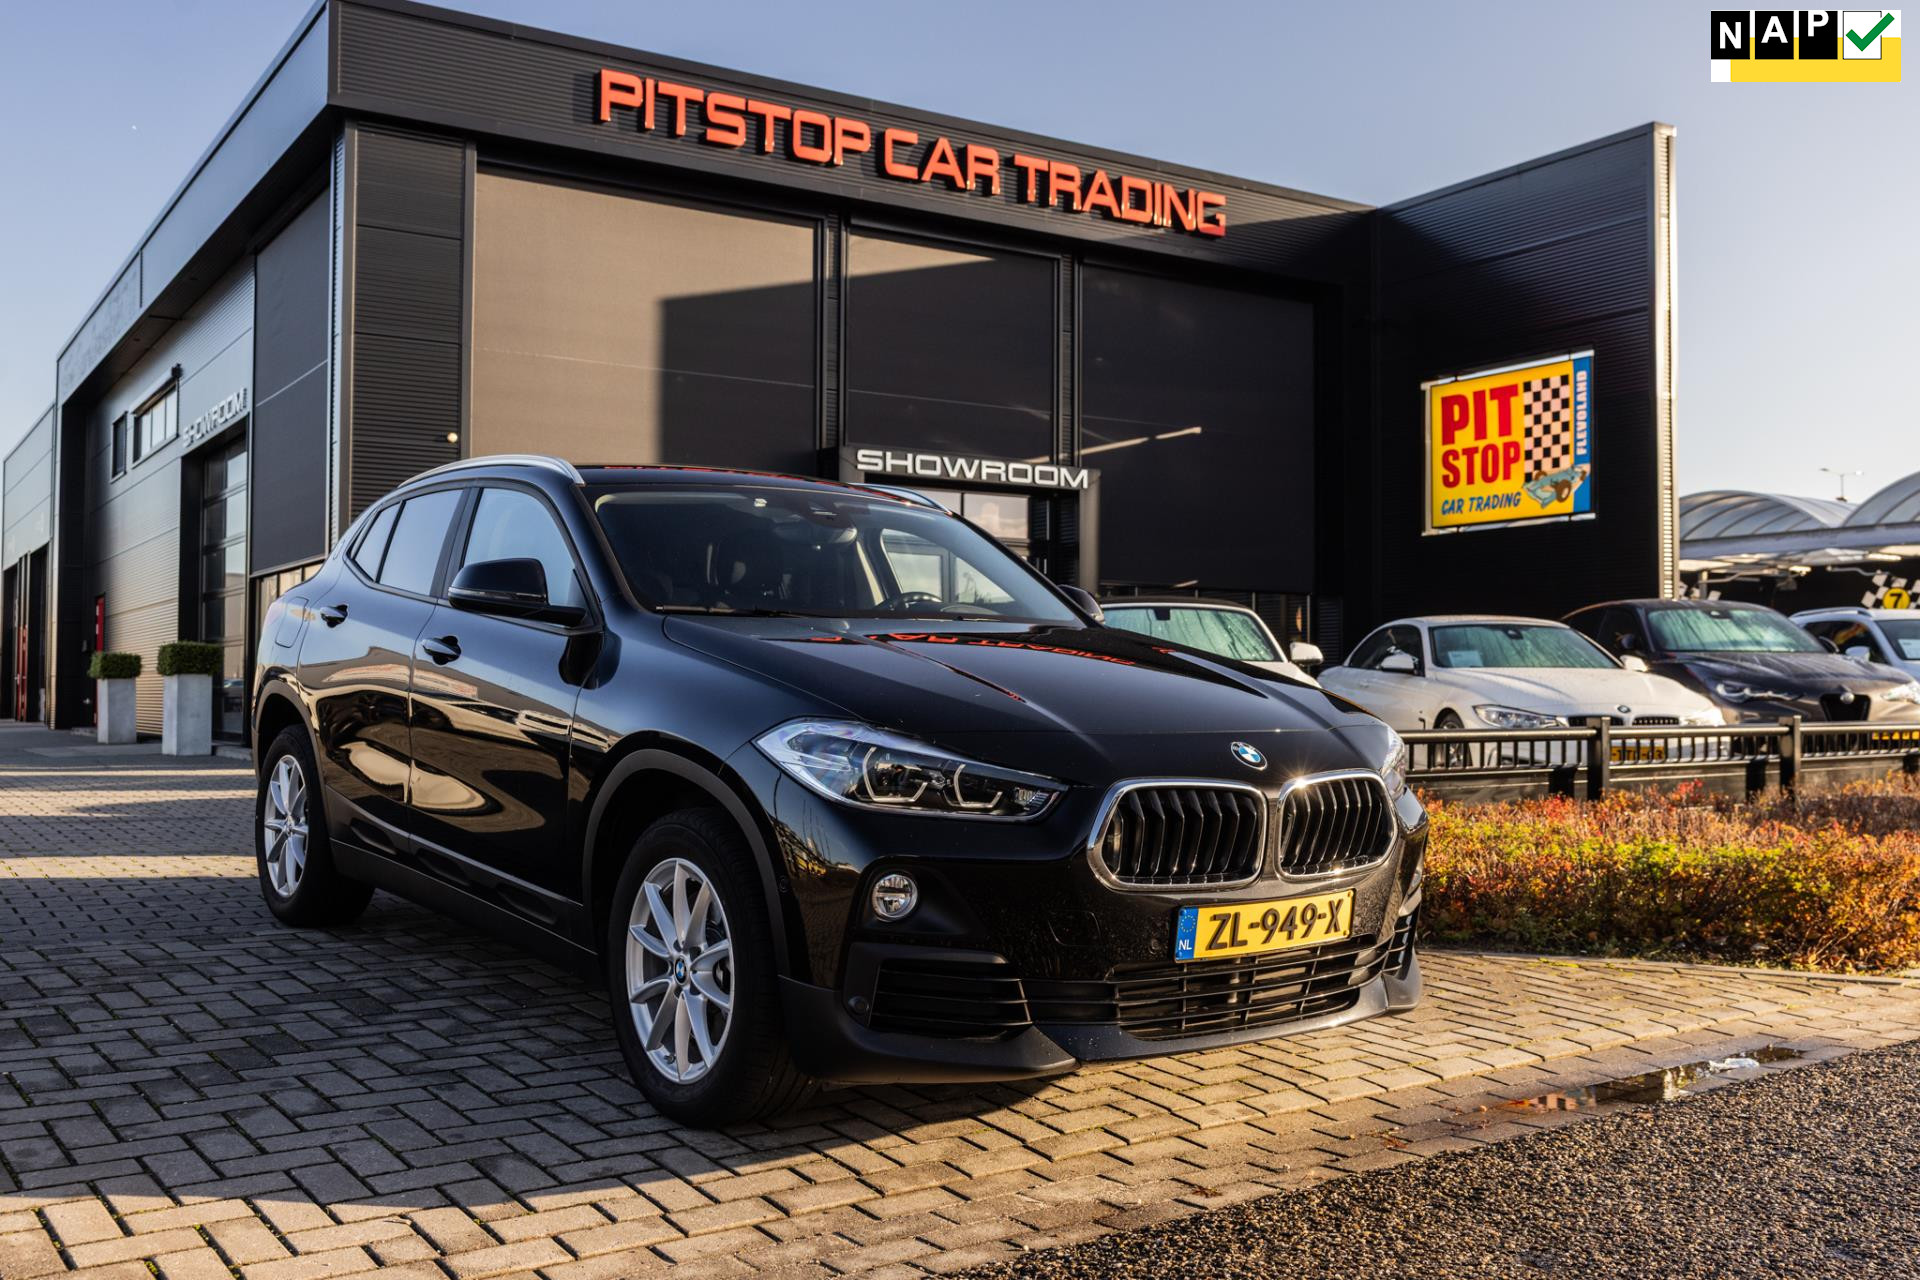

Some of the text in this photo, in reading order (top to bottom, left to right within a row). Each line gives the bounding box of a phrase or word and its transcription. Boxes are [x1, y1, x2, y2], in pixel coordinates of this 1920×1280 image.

[600, 69, 1226, 236] PITSTOP CAR TRADING
[183, 388, 245, 448] SHOWROOM
[1441, 384, 1519, 446] PIT
[1576, 370, 1588, 456] FLEVOLAND
[857, 449, 1089, 489] SHOWROOM
[1441, 441, 1521, 489] STOP
[1441, 492, 1522, 515] CAR TRADING
[1889, 593, 1903, 608] 7
[1178, 939, 1193, 950] NL
[1205, 898, 1344, 951] ZL-949-X
